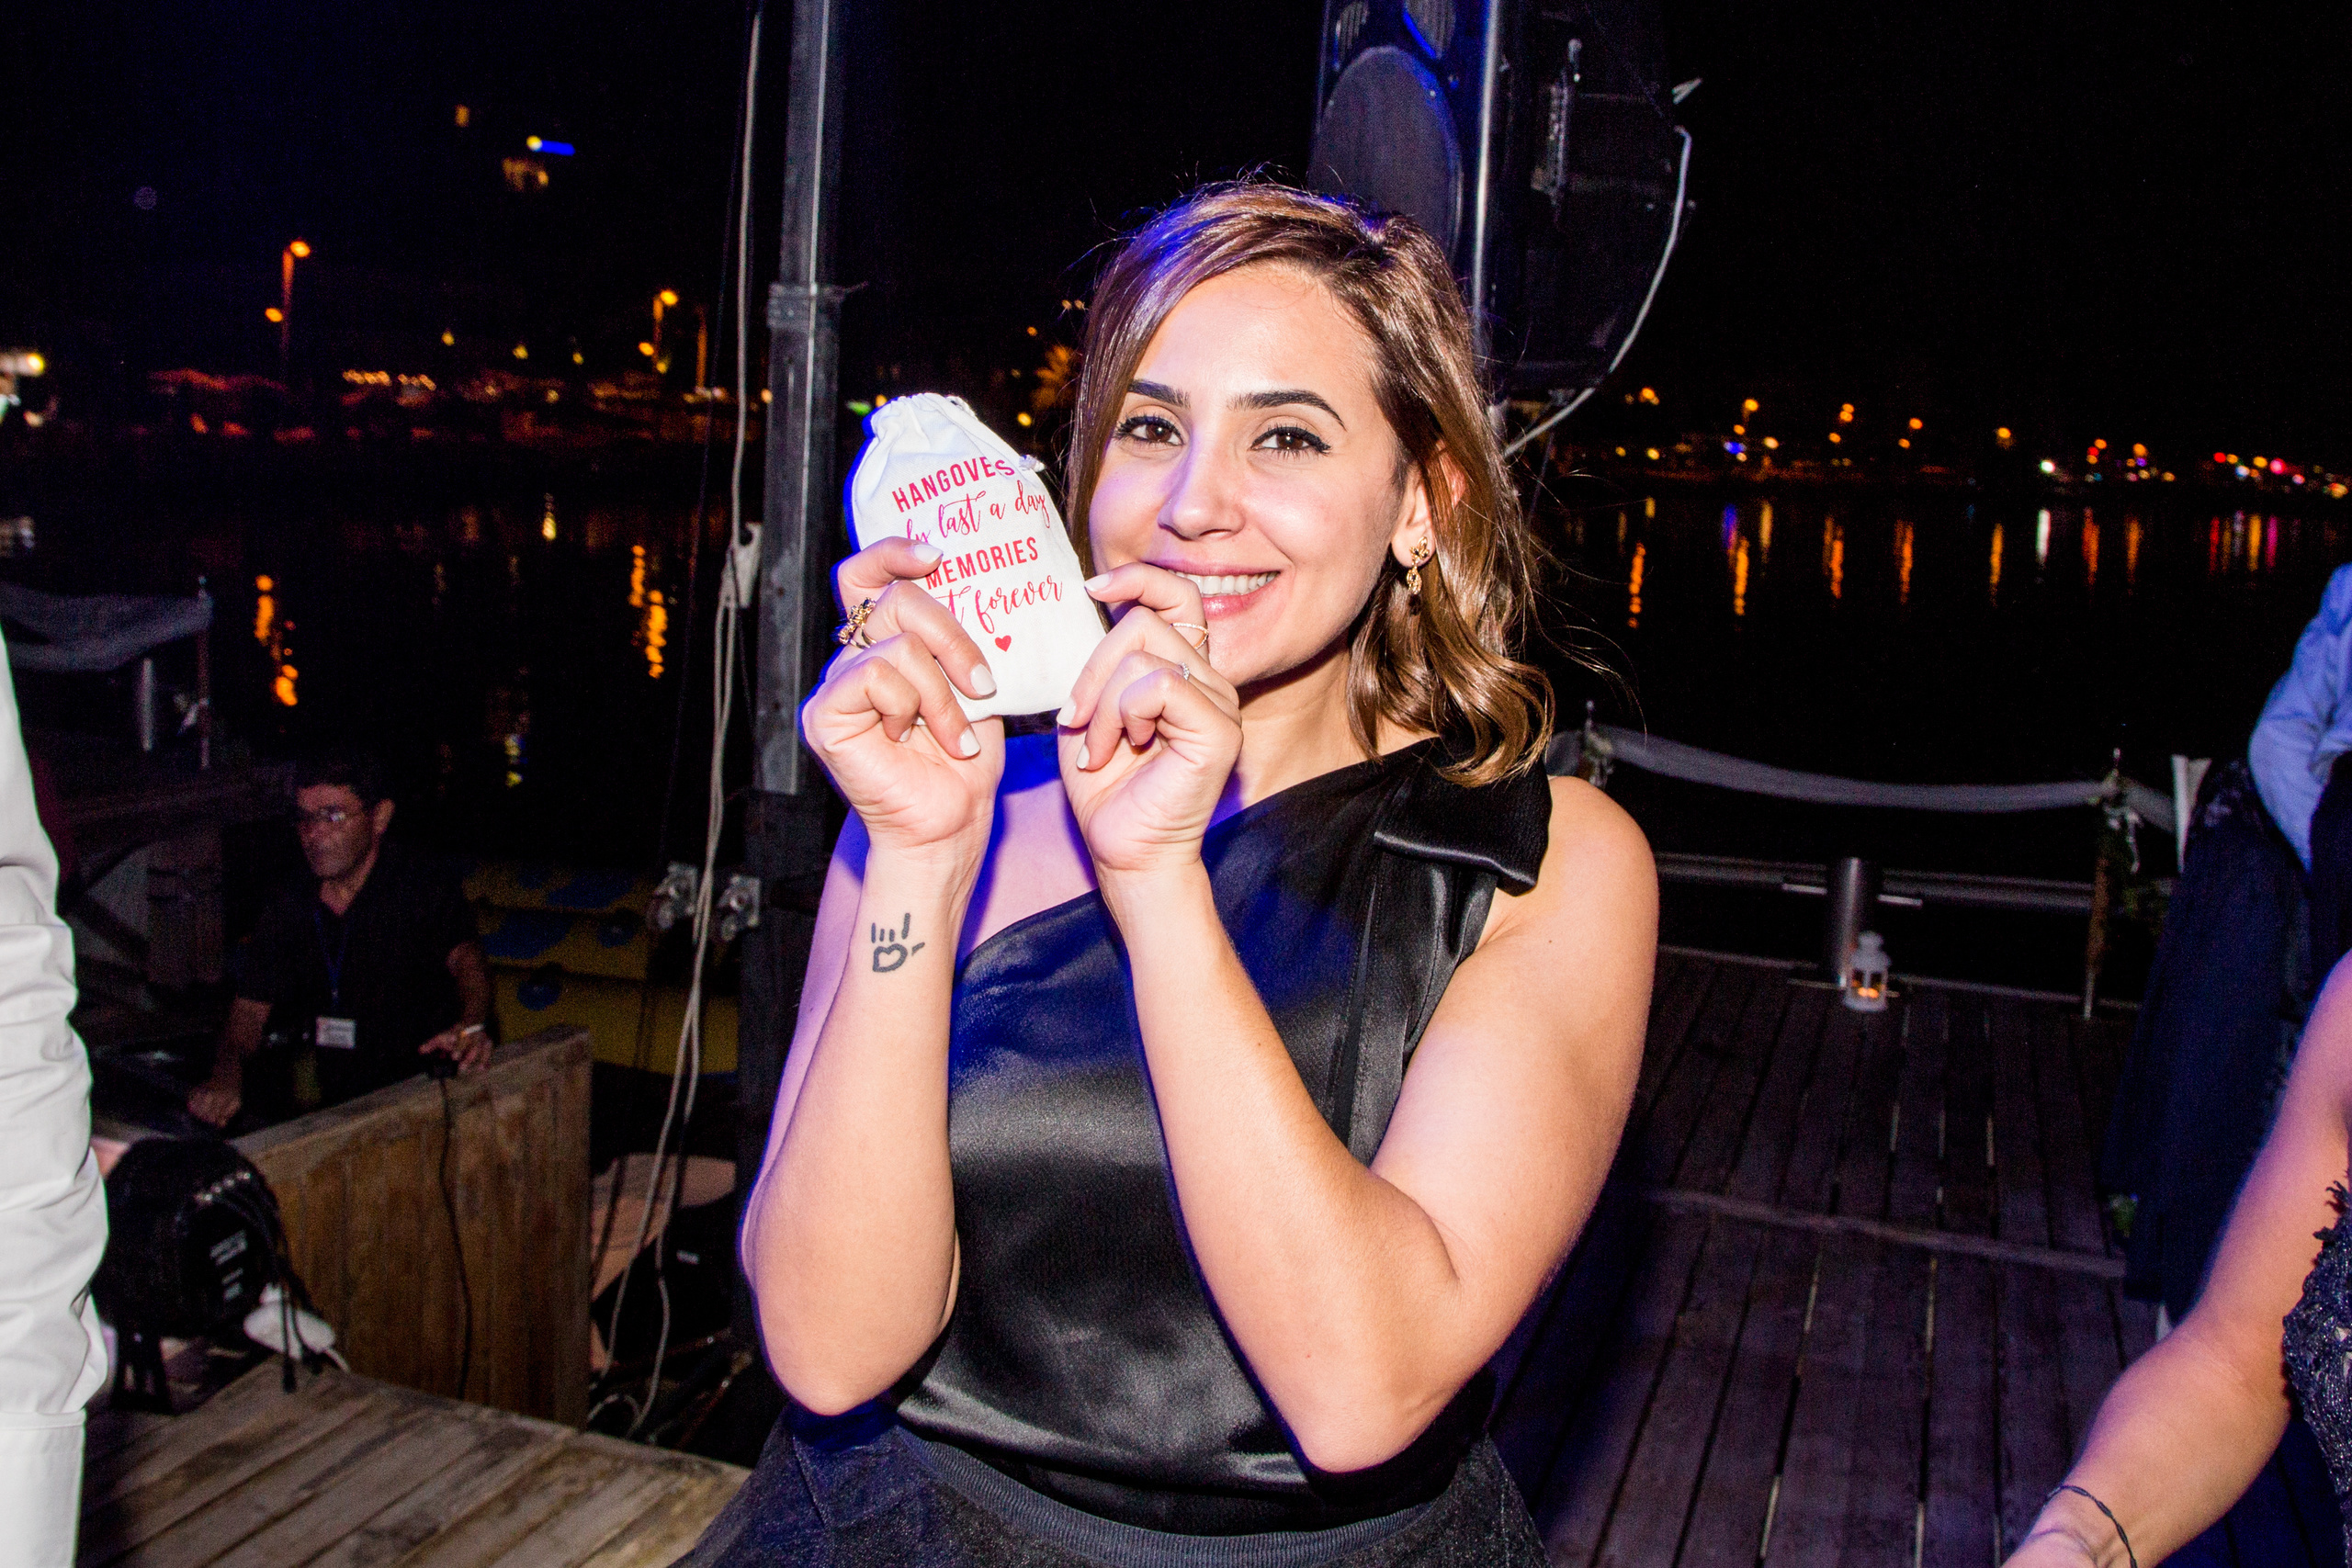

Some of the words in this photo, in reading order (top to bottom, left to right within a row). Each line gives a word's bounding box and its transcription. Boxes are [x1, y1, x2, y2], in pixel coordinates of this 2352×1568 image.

[892, 457, 1015, 513] HANGOVES
[938, 491, 987, 538] last
[989, 502, 1006, 520] a
[1014, 479, 1050, 529] day
[926, 536, 1038, 590] MEMORIES
[975, 574, 1063, 634] forever
